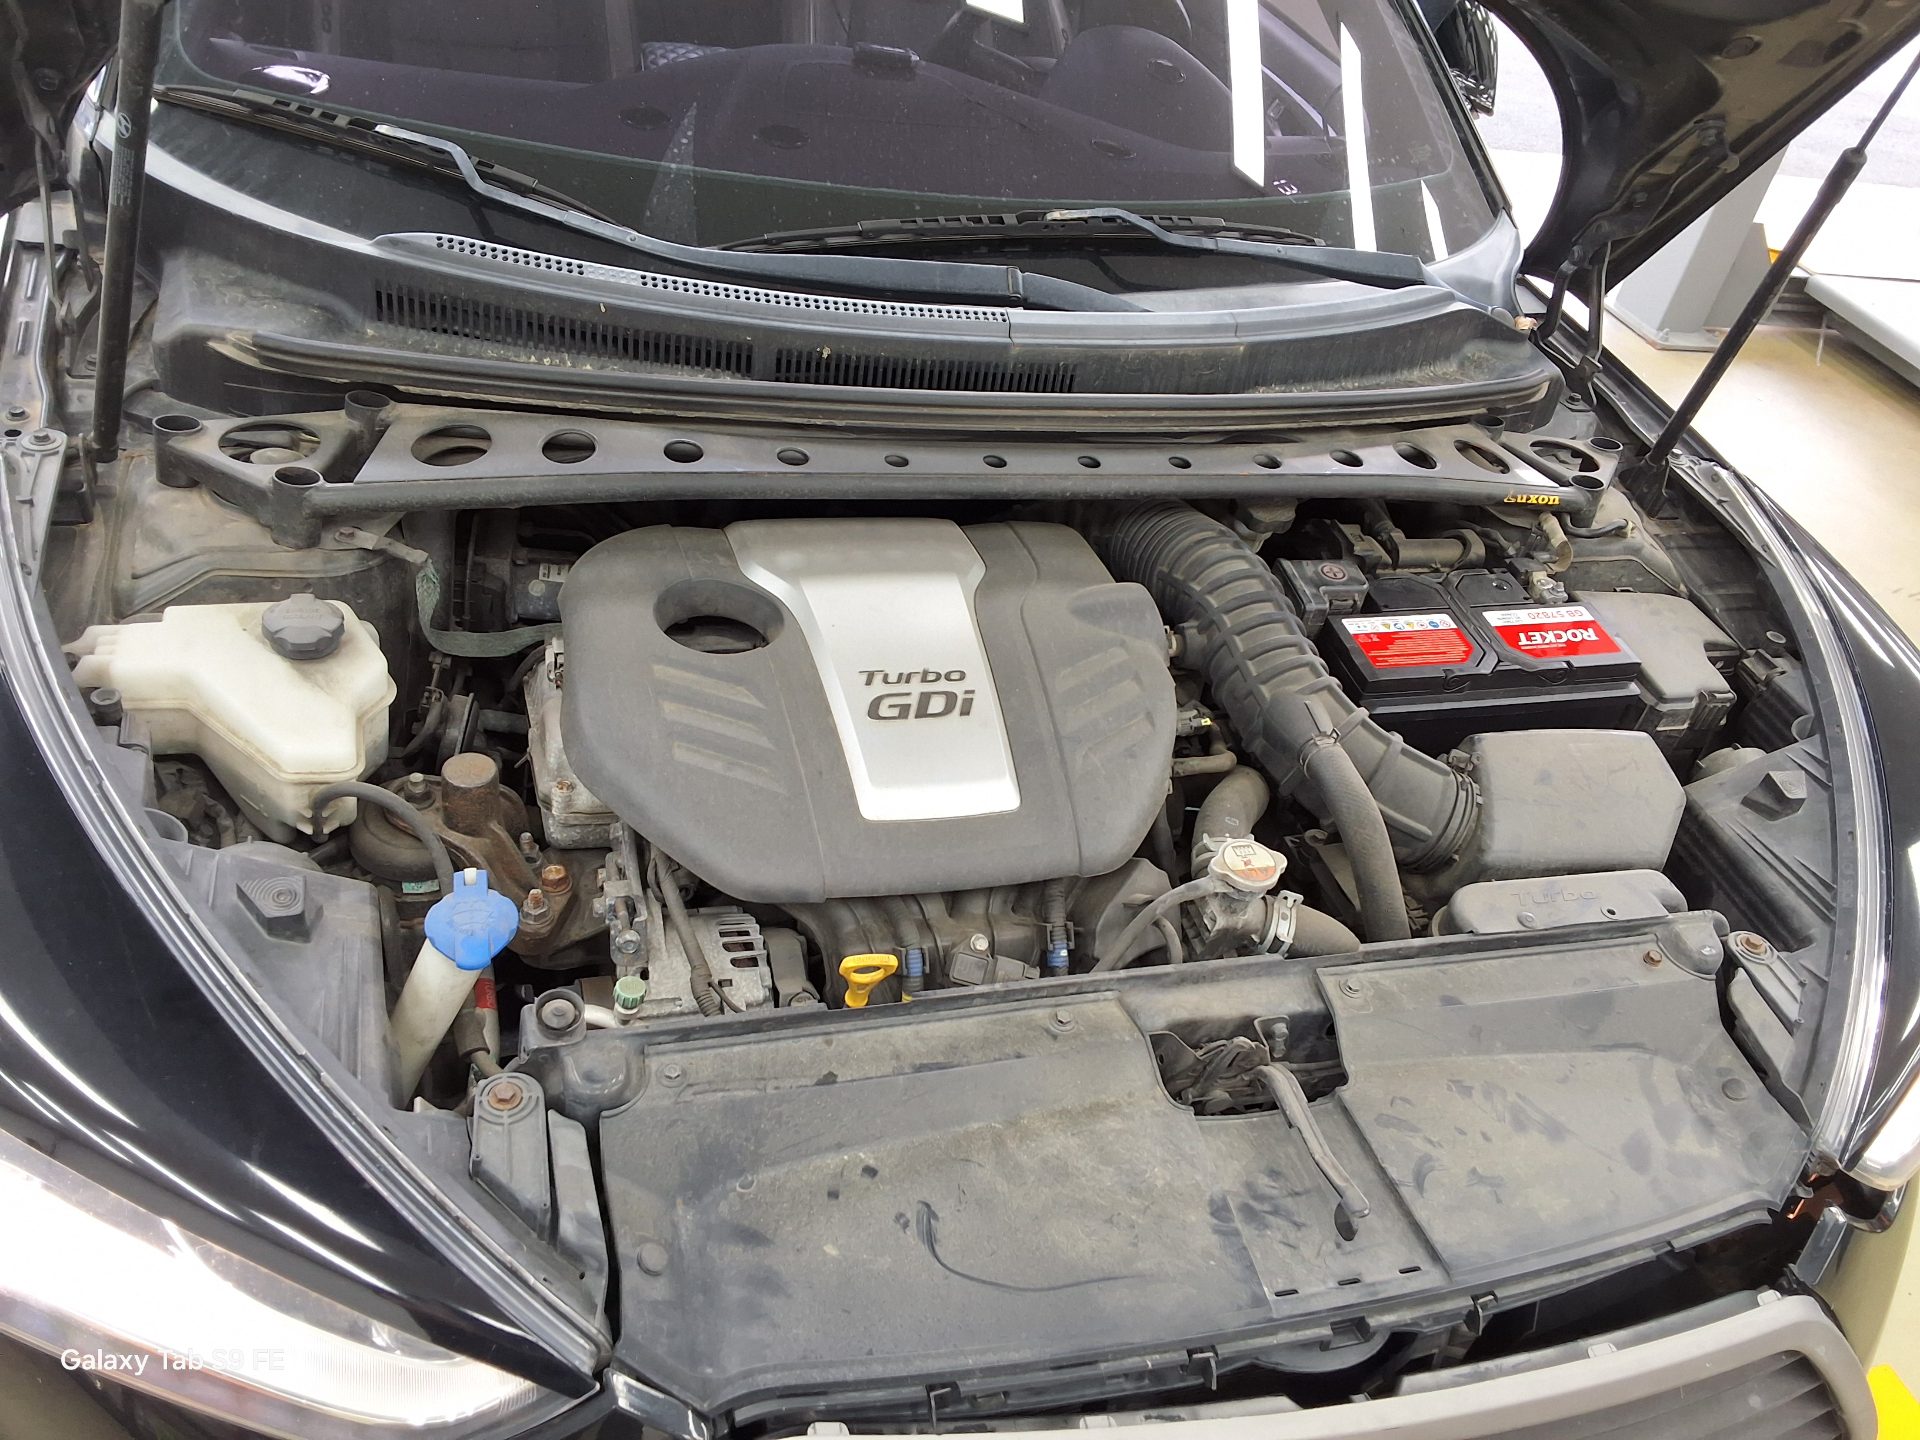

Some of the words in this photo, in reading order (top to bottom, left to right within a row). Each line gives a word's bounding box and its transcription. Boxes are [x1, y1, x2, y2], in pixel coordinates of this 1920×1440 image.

[1528, 611, 1564, 620] 57820
[1570, 609, 1584, 618] GB
[1518, 627, 1599, 646] ROCKET
[858, 668, 966, 686] Turbo
[867, 690, 975, 721] GDi
[1511, 887, 1599, 907] Turbo
